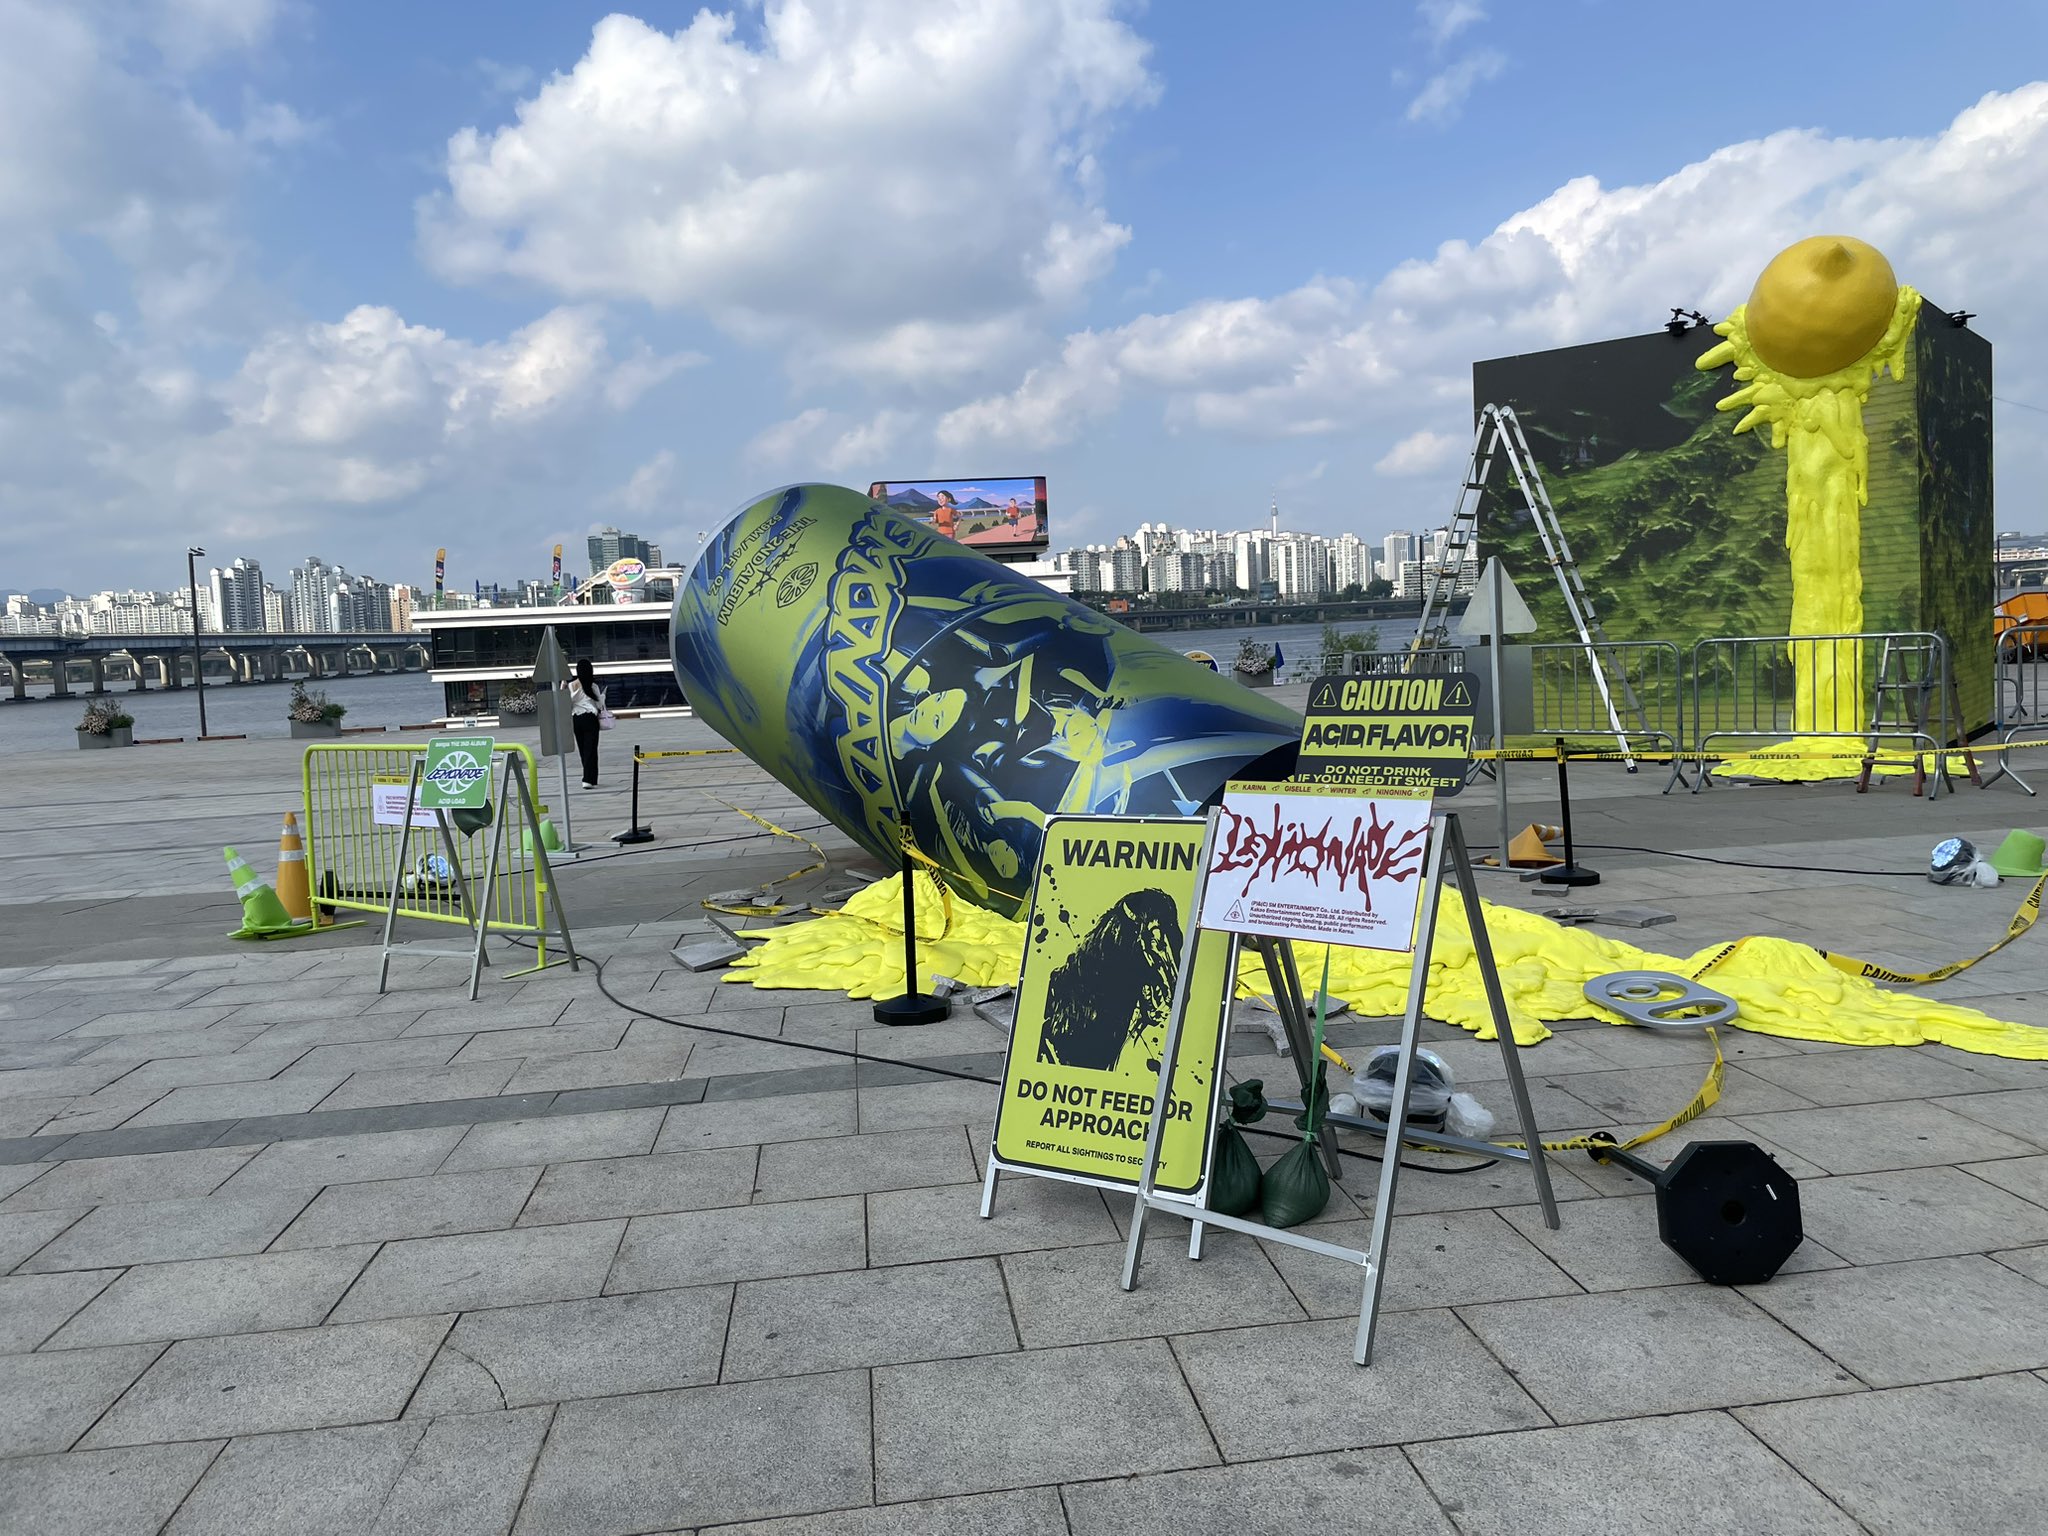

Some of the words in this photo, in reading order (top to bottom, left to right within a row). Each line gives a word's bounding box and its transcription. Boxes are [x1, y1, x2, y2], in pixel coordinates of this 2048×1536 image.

[780, 516, 818, 540] THE
[751, 536, 784, 566] 2ND
[717, 562, 756, 626] ALBUM
[1340, 678, 1444, 712] CAUTION
[1304, 724, 1366, 750] ACID
[1366, 724, 1469, 752] FLAVOR
[426, 768, 486, 780] LEMONADE
[1298, 774, 1310, 783] IF
[1313, 774, 1344, 784] YOU
[1345, 776, 1385, 785] NEED
[1387, 776, 1403, 786] IT
[1404, 777, 1460, 788] SWEET
[1325, 764, 1346, 775] DO
[1349, 766, 1381, 776] NOT
[1383, 766, 1432, 777] DRINK
[1062, 838, 1203, 871] WARNIN
[1266, 908, 1301, 916] Entertainment
[1277, 903, 1320, 912] ENTERTAINMENT
[1342, 909, 1371, 917] Distributed
[1258, 919, 1289, 928] broadcasting
[1340, 922, 1374, 930] performance
[1016, 1078, 1048, 1101] DO
[1052, 1083, 1097, 1108] NOT
[1100, 1090, 1155, 1116] FEED
[1026, 1139, 1056, 1151] REPORT
[1056, 1144, 1071, 1154] ALL
[1071, 1147, 1114, 1161] SIGHTINGS
[1115, 1154, 1126, 1163] TO
